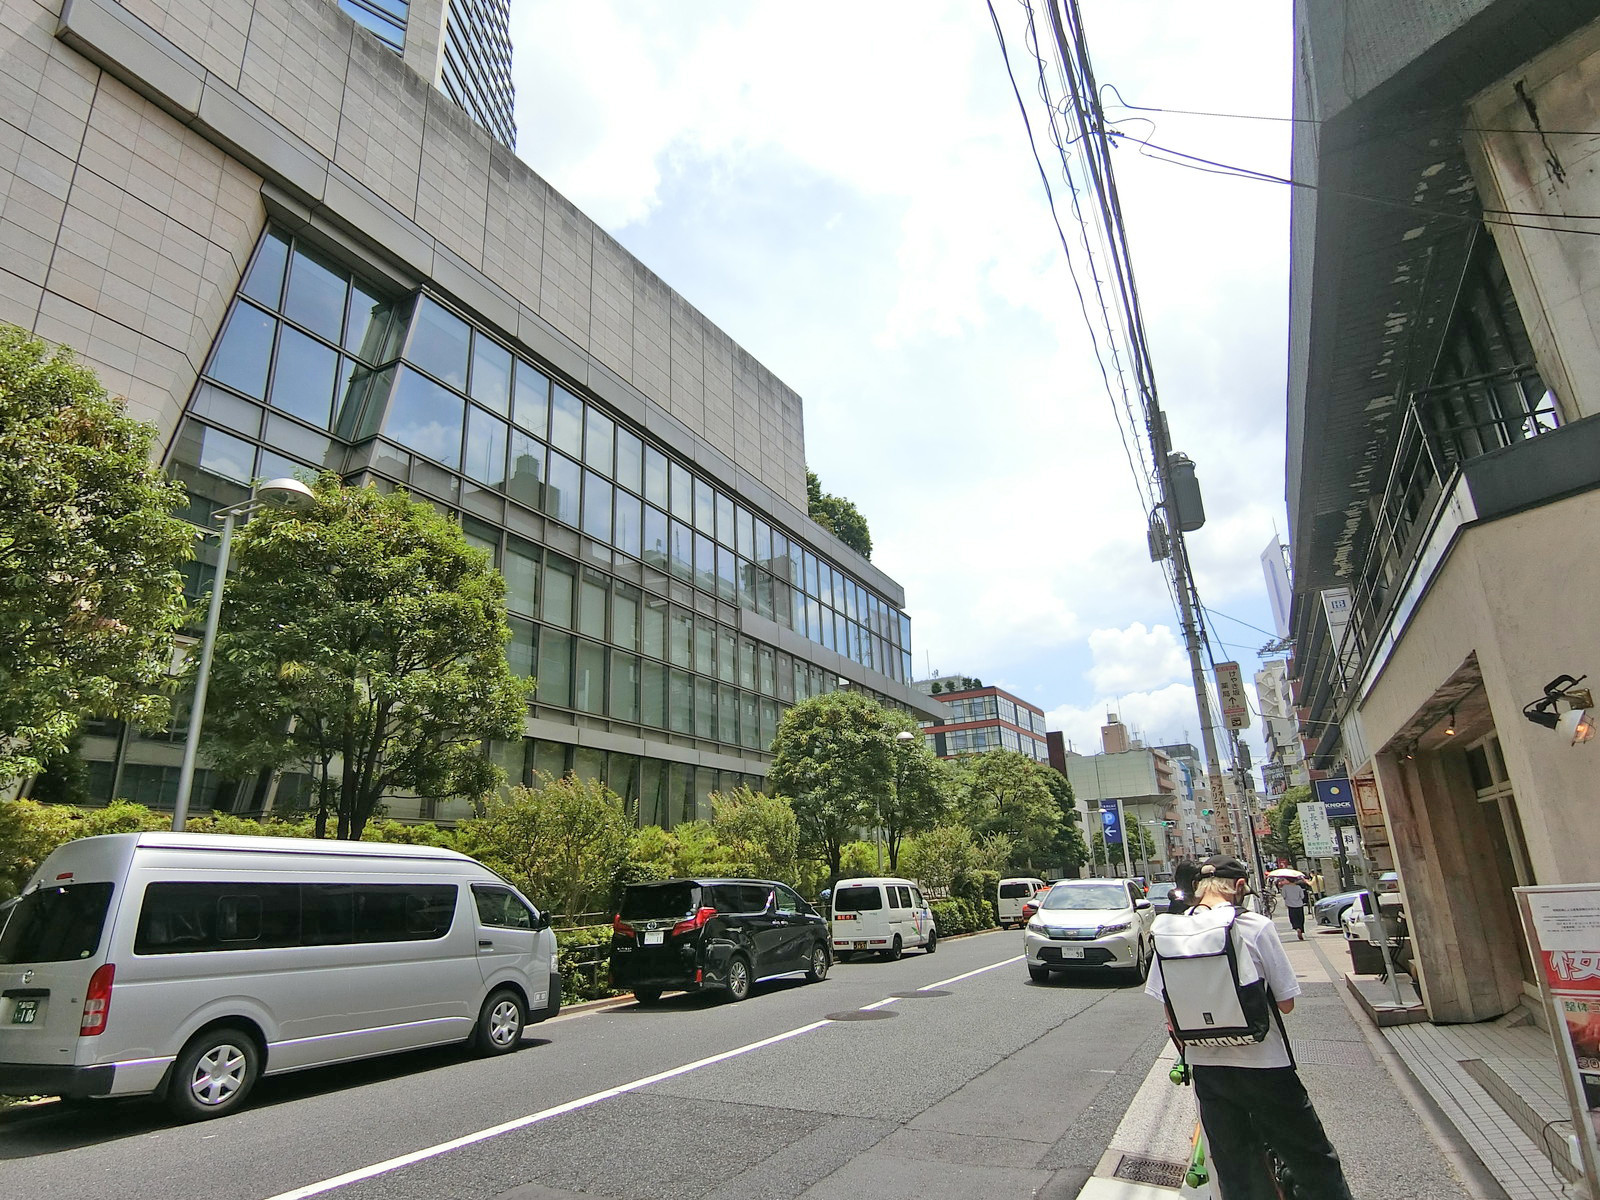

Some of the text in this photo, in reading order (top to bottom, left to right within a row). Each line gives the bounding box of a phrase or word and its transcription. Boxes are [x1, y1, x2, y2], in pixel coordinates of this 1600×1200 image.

[1221, 682, 1230, 697] 薬局
[1228, 671, 1240, 696] けやき坂
[1104, 813, 1113, 824] P
[1184, 1034, 1259, 1048] CHROME
